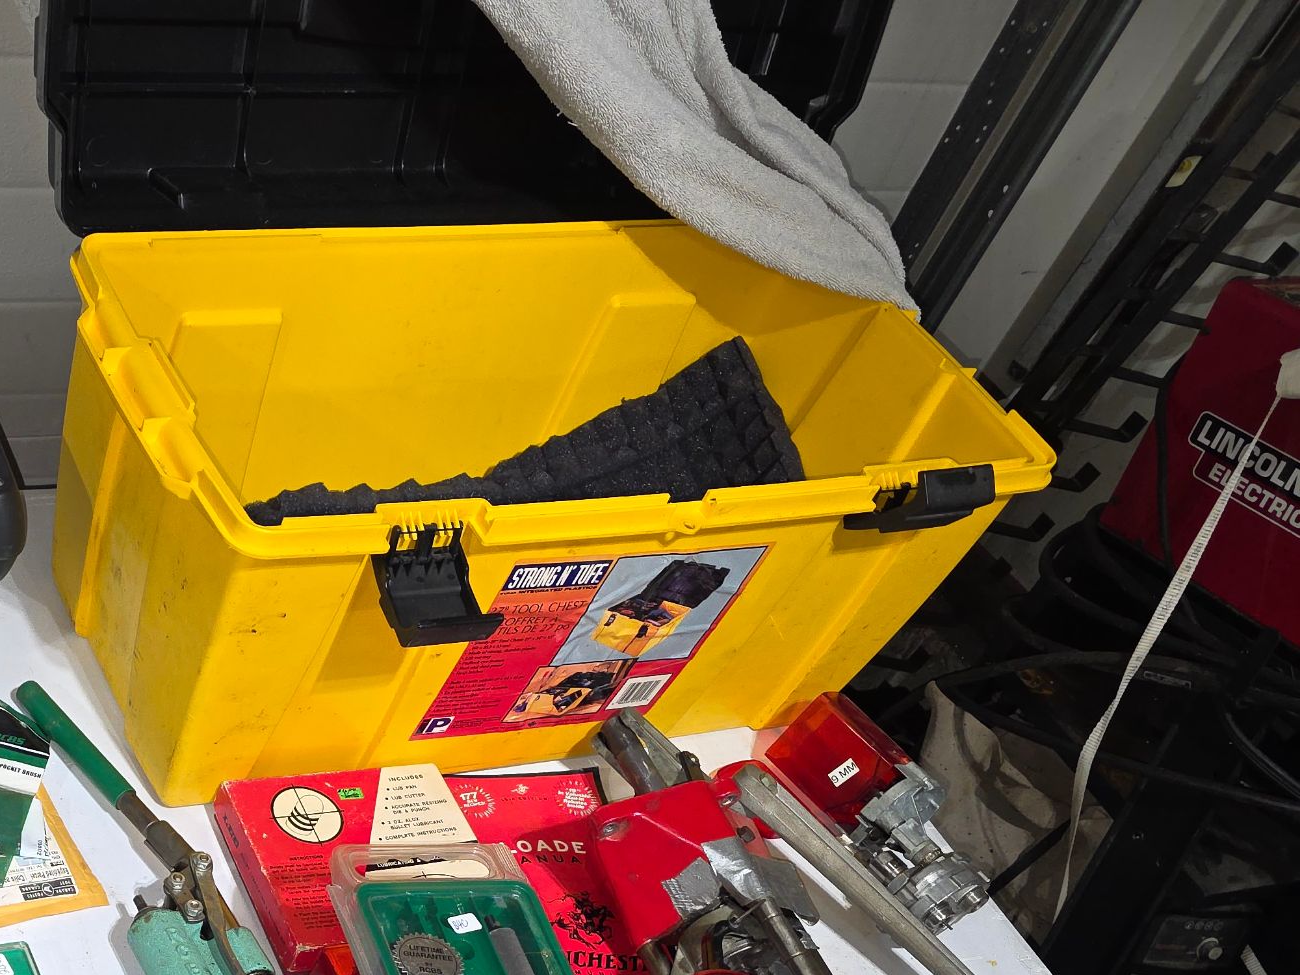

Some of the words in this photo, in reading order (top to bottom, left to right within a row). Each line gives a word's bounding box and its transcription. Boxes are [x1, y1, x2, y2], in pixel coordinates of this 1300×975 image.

[1197, 420, 1300, 498] LINCOLN
[1208, 462, 1300, 529] ELECTRIC
[508, 565, 559, 589] STRONG
[512, 603, 544, 614] TOOL
[548, 600, 588, 613] CHEST
[497, 625, 519, 635] TILS
[521, 624, 538, 634] DE
[539, 623, 556, 632] 27
[0, 763, 21, 773] POCKET
[21, 768, 42, 779] BRUSH
[830, 774, 839, 784] 9
[838, 762, 857, 778] MM
[388, 774, 424, 782] INCLUDES
[460, 791, 477, 800] 177
[391, 802, 420, 810] ACCURATE
[413, 819, 444, 827] LUBRICANT
[417, 826, 457, 837] INSTRUCTIONS
[511, 839, 587, 854] OADE
[520, 854, 582, 864] ANUA
[30, 870, 46, 880] Parcel
[409, 945, 444, 954] LIFETIME
[403, 950, 454, 962] GUARANTEE
[567, 950, 650, 972] CHEST
[419, 966, 443, 975] RCBS
